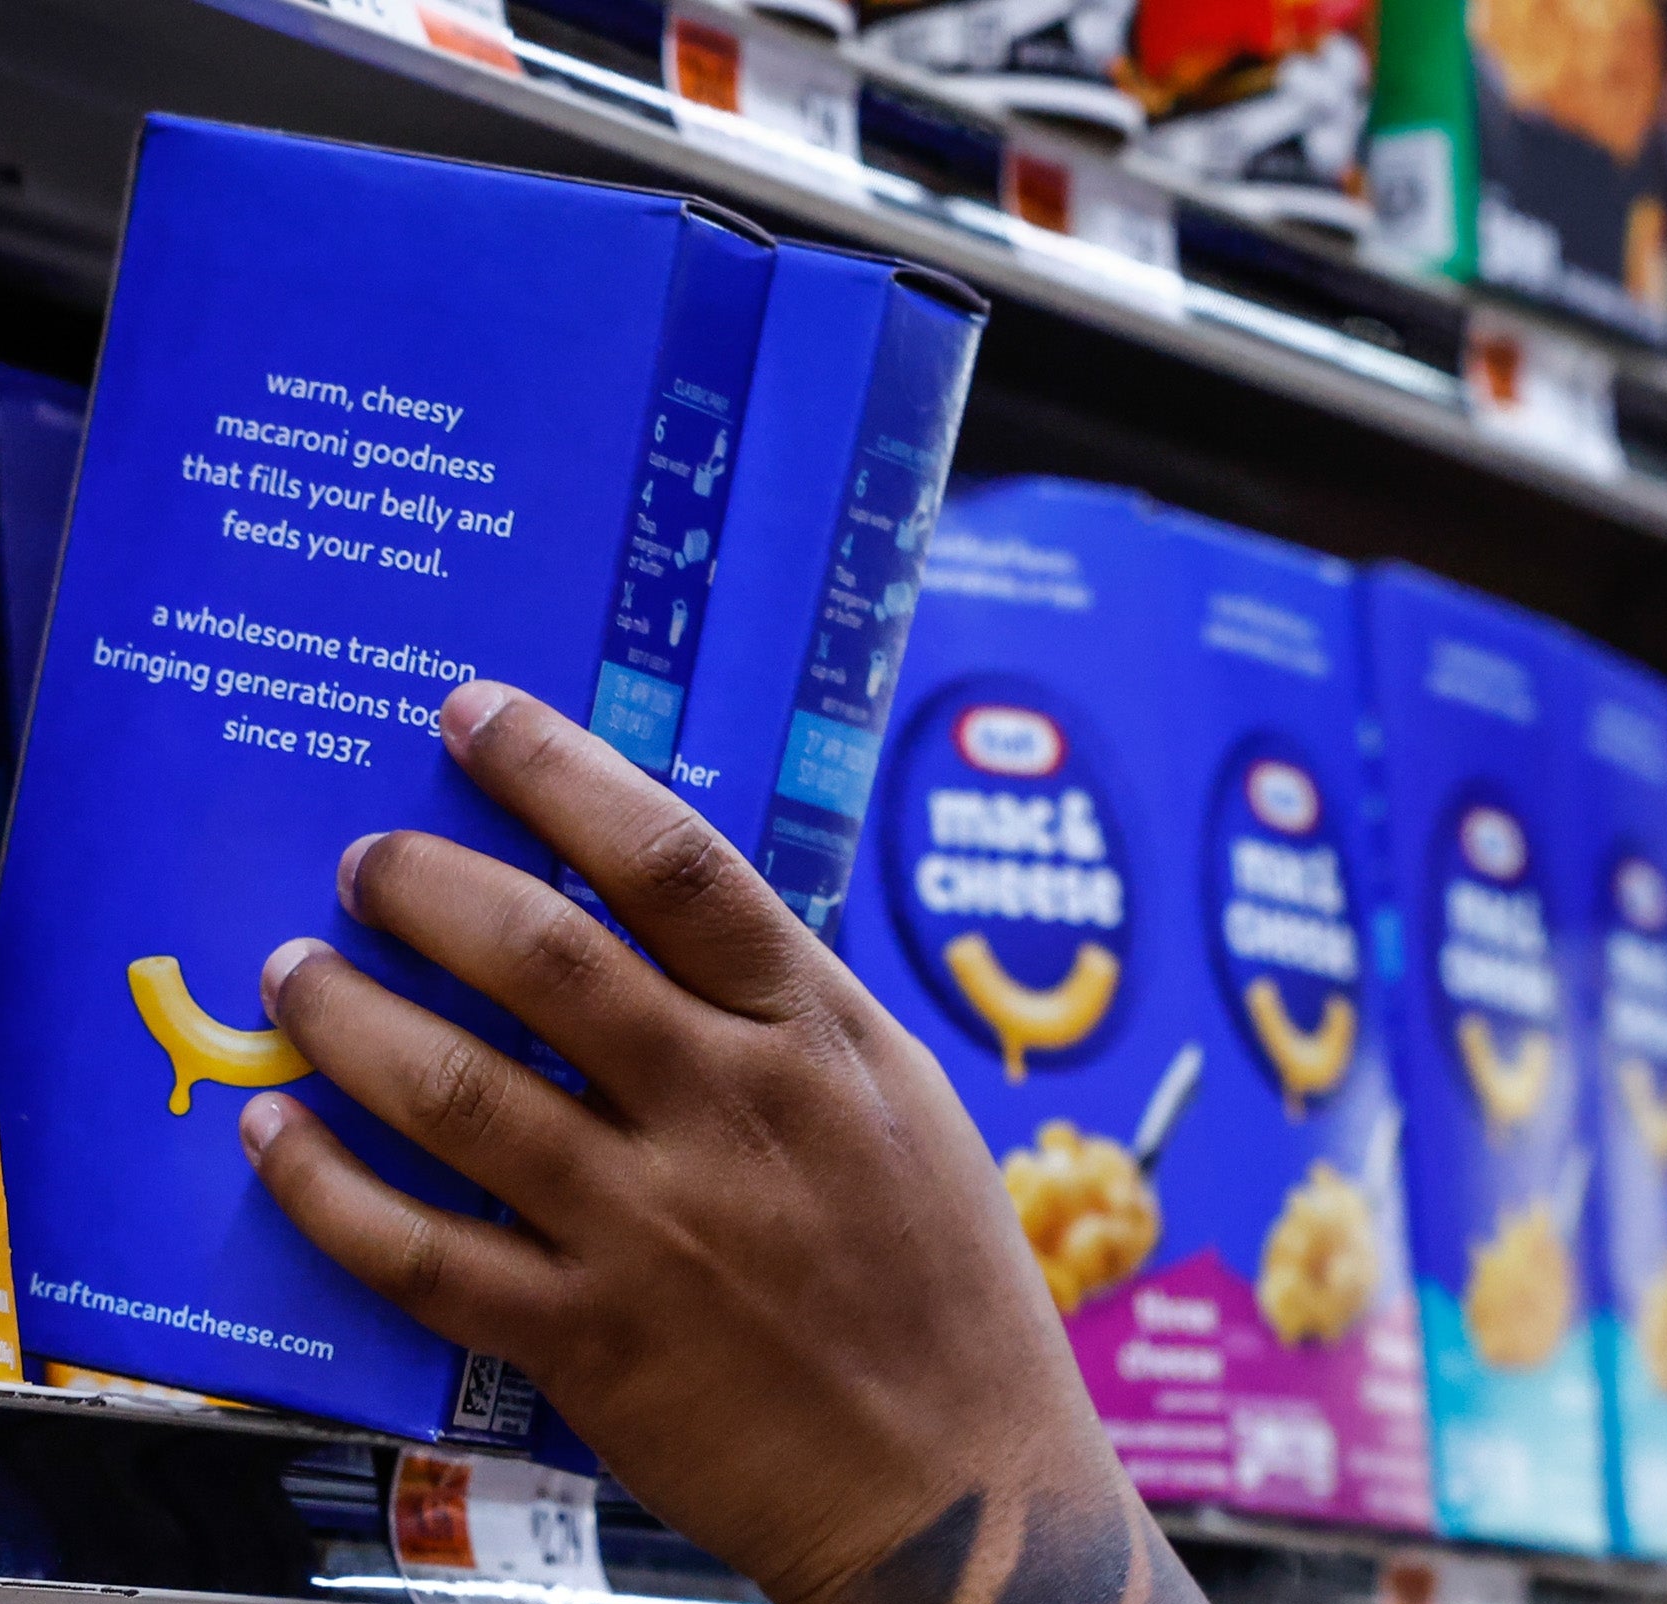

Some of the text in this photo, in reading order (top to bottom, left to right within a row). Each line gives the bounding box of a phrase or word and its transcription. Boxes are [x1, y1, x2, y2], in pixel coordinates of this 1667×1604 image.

[267, 371, 464, 433] warm, cheesy
[654, 414, 668, 443] 6
[215, 414, 496, 484] macaroni goodness
[853, 469, 870, 498] 6
[182, 452, 515, 539] that fills your belly and
[642, 479, 654, 508] 4
[222, 508, 449, 579] feeds your soul.
[93, 637, 211, 692] bringing
[215, 667, 391, 720] generations
[152, 605, 476, 683] a wholesome tradition
[223, 715, 372, 768] since 1937.
[30, 1273, 333, 1360] kraftmacandcheese.com
